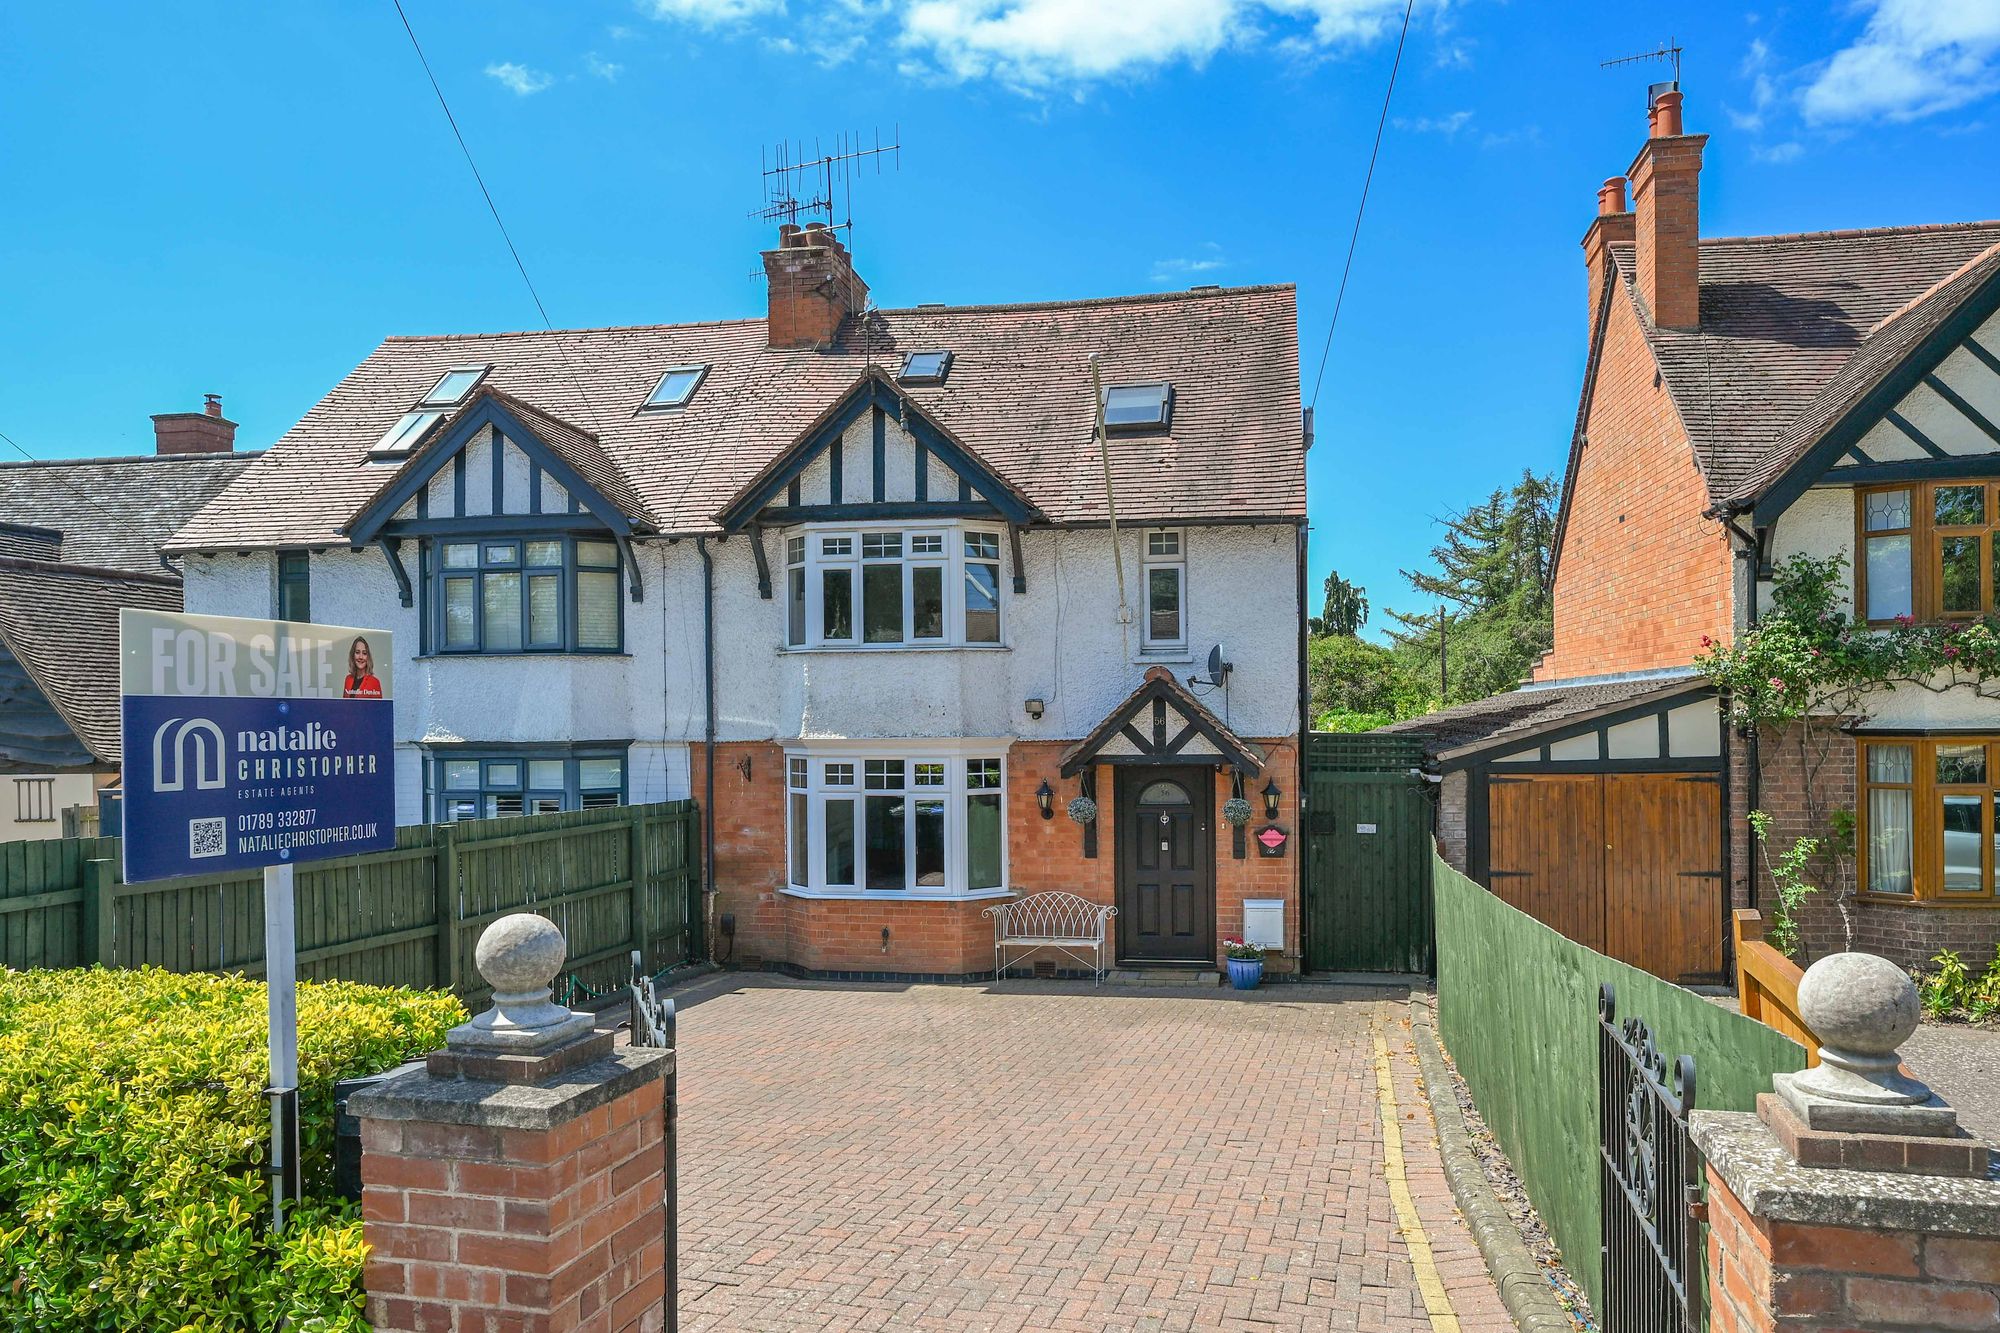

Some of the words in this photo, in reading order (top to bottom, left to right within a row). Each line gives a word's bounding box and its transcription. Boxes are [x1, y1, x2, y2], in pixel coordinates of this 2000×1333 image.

[152, 628, 237, 696] FOR
[250, 634, 333, 698] SALE
[1154, 717, 1165, 726] 56
[237, 722, 336, 752] natalie
[238, 754, 377, 781] CHRISTOPHER
[238, 788, 274, 799] ESTATE
[281, 785, 315, 797] AGENTS
[238, 812, 273, 832] 01789
[278, 808, 317, 828] 332877
[239, 822, 378, 854] NATALIECHRISTOPHER.CO.UK
